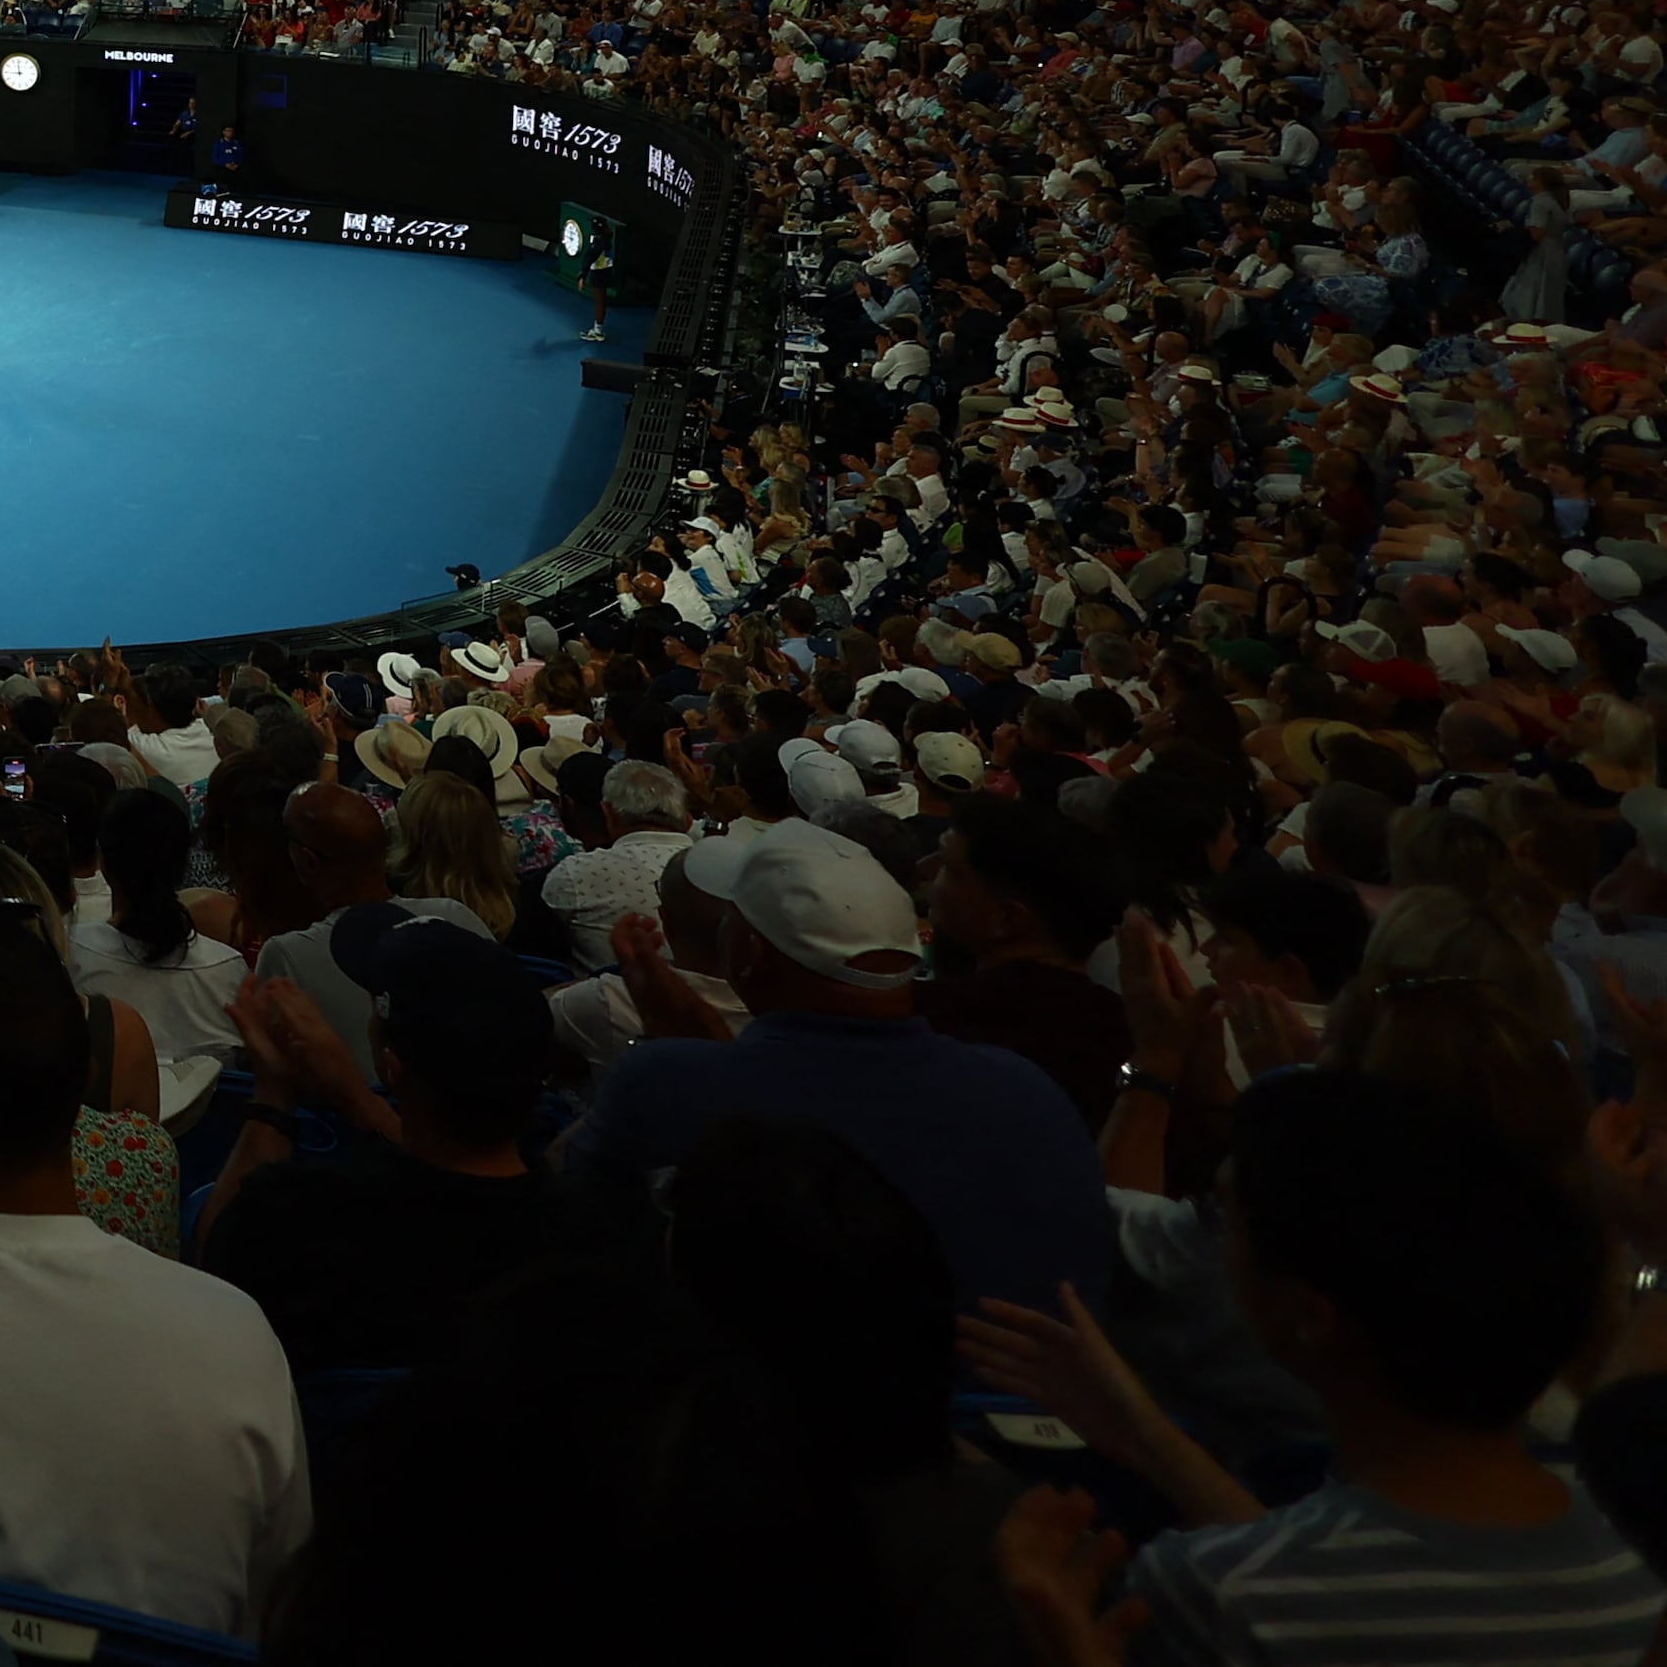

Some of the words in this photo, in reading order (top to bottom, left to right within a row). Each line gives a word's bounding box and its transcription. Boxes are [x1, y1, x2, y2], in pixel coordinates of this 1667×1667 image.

[105, 50, 174, 63] MELBOURNE
[511, 134, 579, 161] GUOJIAO
[589, 155, 620, 174] 1573
[192, 216, 259, 230] GUOJIAO
[272, 223, 307, 235] 1573
[341, 231, 414, 246] GUOJIAO
[428, 239, 466, 251] 1573
[12, 1619, 42, 1644] 441
